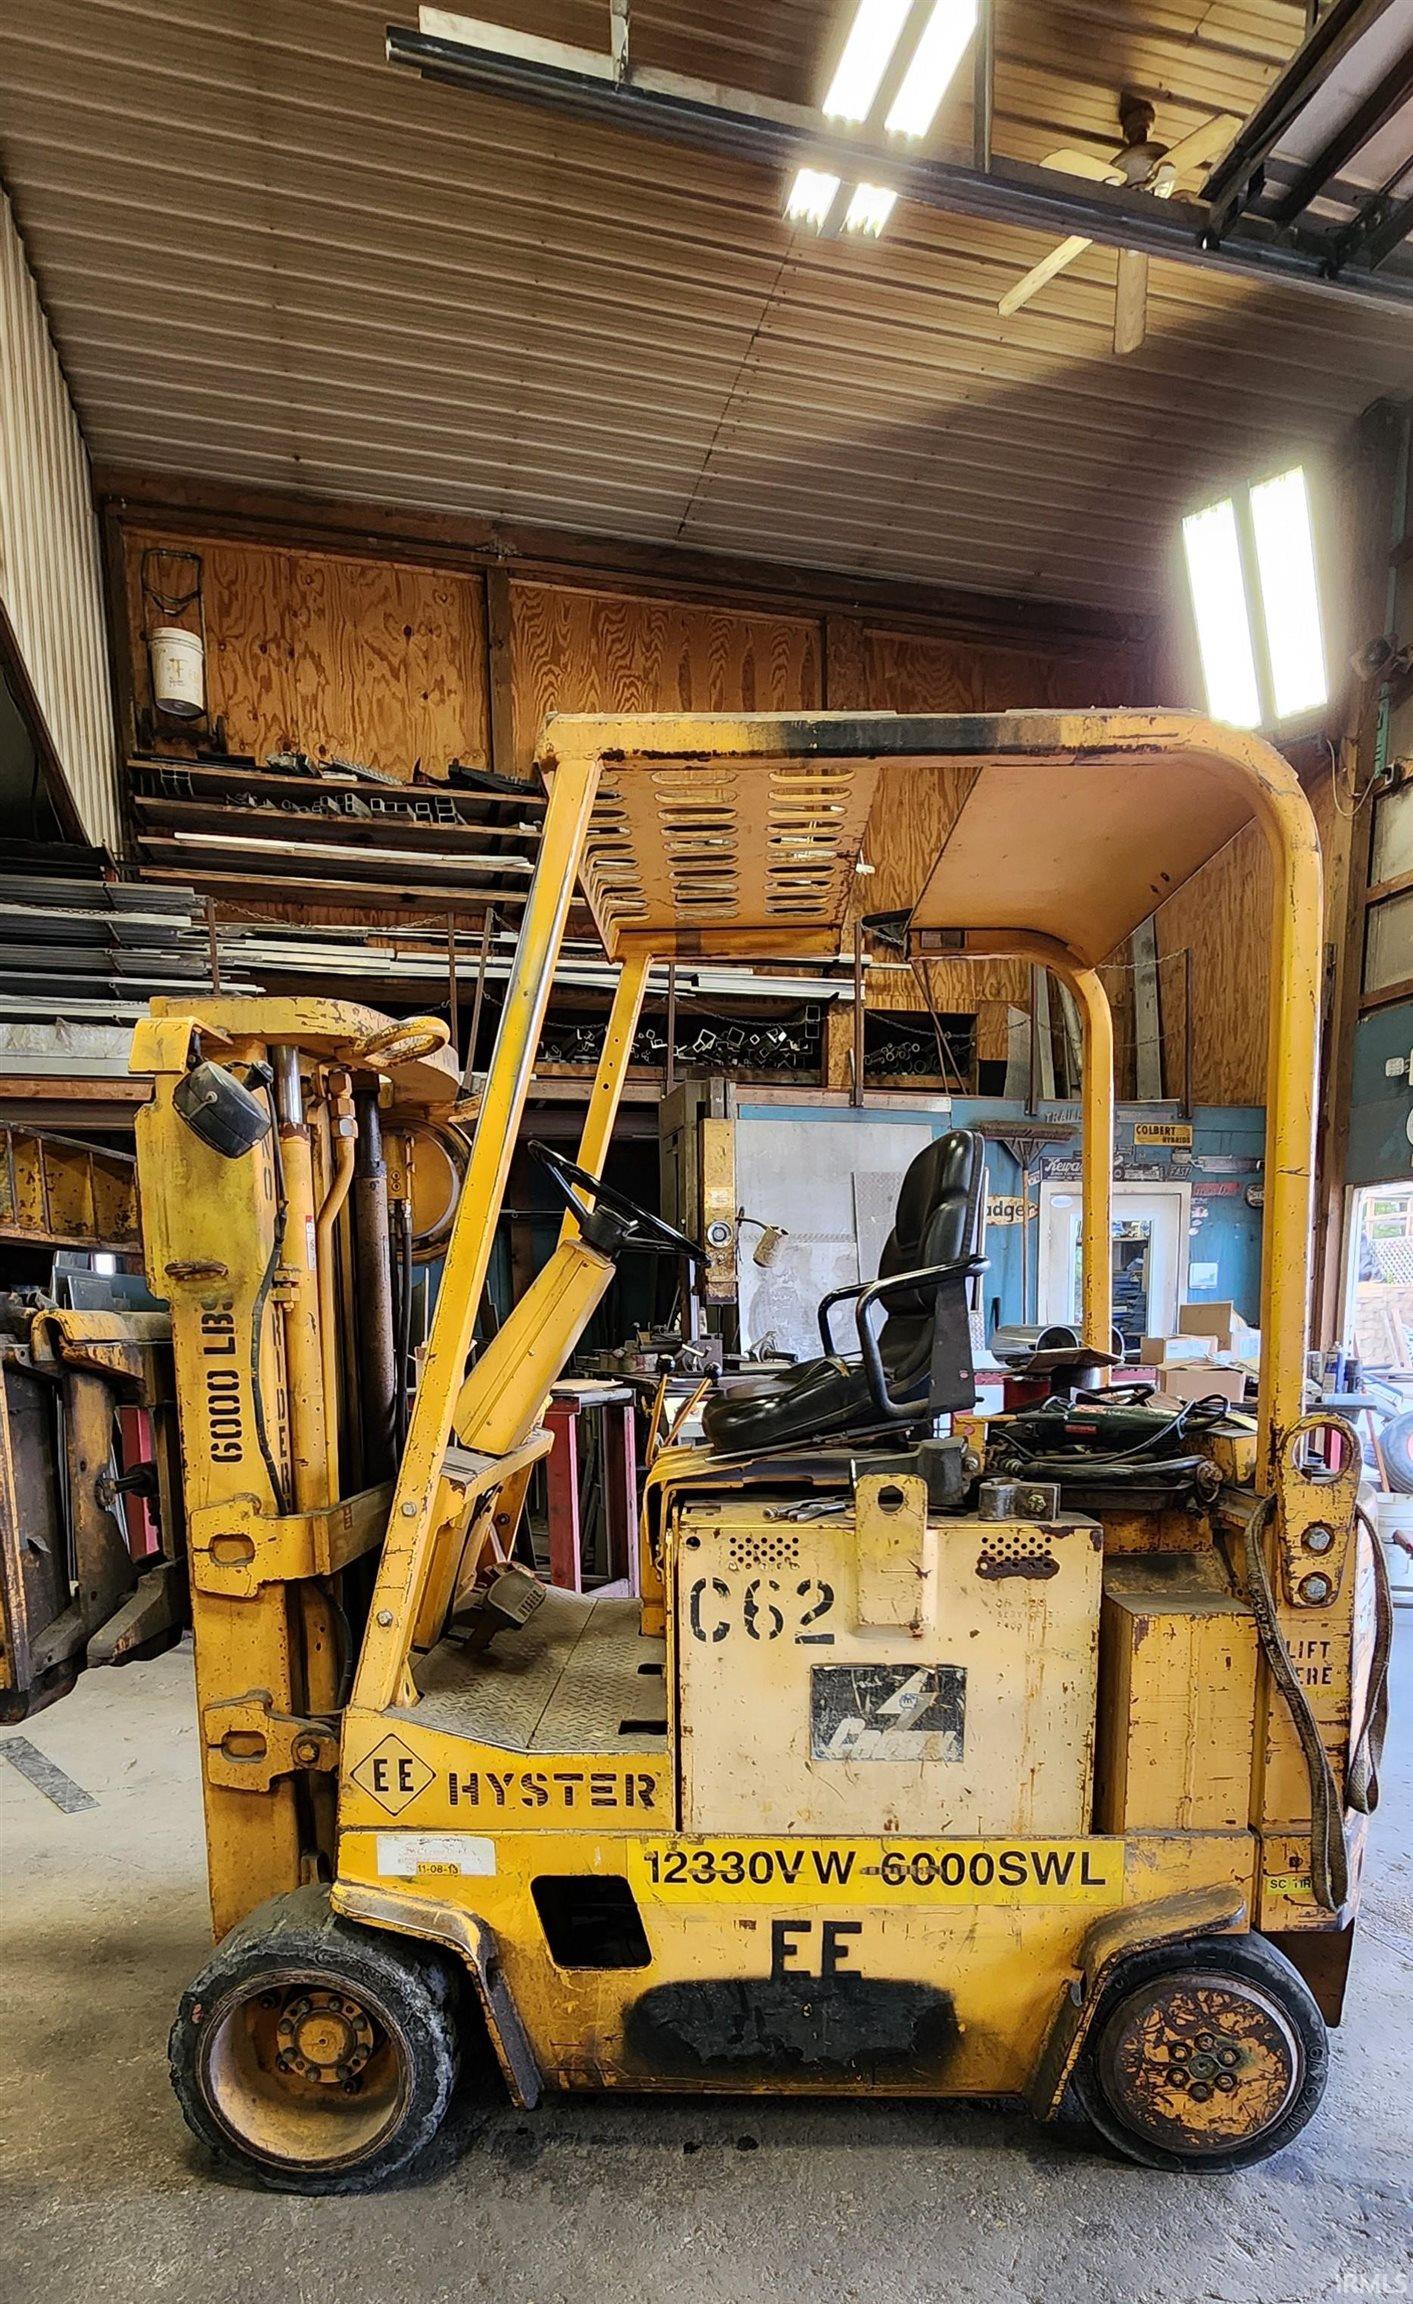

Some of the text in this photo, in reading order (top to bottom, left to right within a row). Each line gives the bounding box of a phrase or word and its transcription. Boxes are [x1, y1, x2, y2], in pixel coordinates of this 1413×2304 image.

[1136, 1125, 1175, 1135] COLBERT
[1045, 1157, 1083, 1172] Kewa
[986, 1200, 1036, 1222] adger
[207, 1370, 243, 1463] 6000
[272, 1309, 291, 1510] RIDER
[690, 1577, 834, 1645] C62
[1286, 1641, 1331, 1658] LIFT
[1296, 1667, 1333, 1685] ERE
[449, 1772, 656, 1807] HYSTER
[881, 1851, 1107, 1886] 6000SWL
[1270, 1878, 1312, 1889] SC TIR
[770, 1919, 862, 1979] EE
